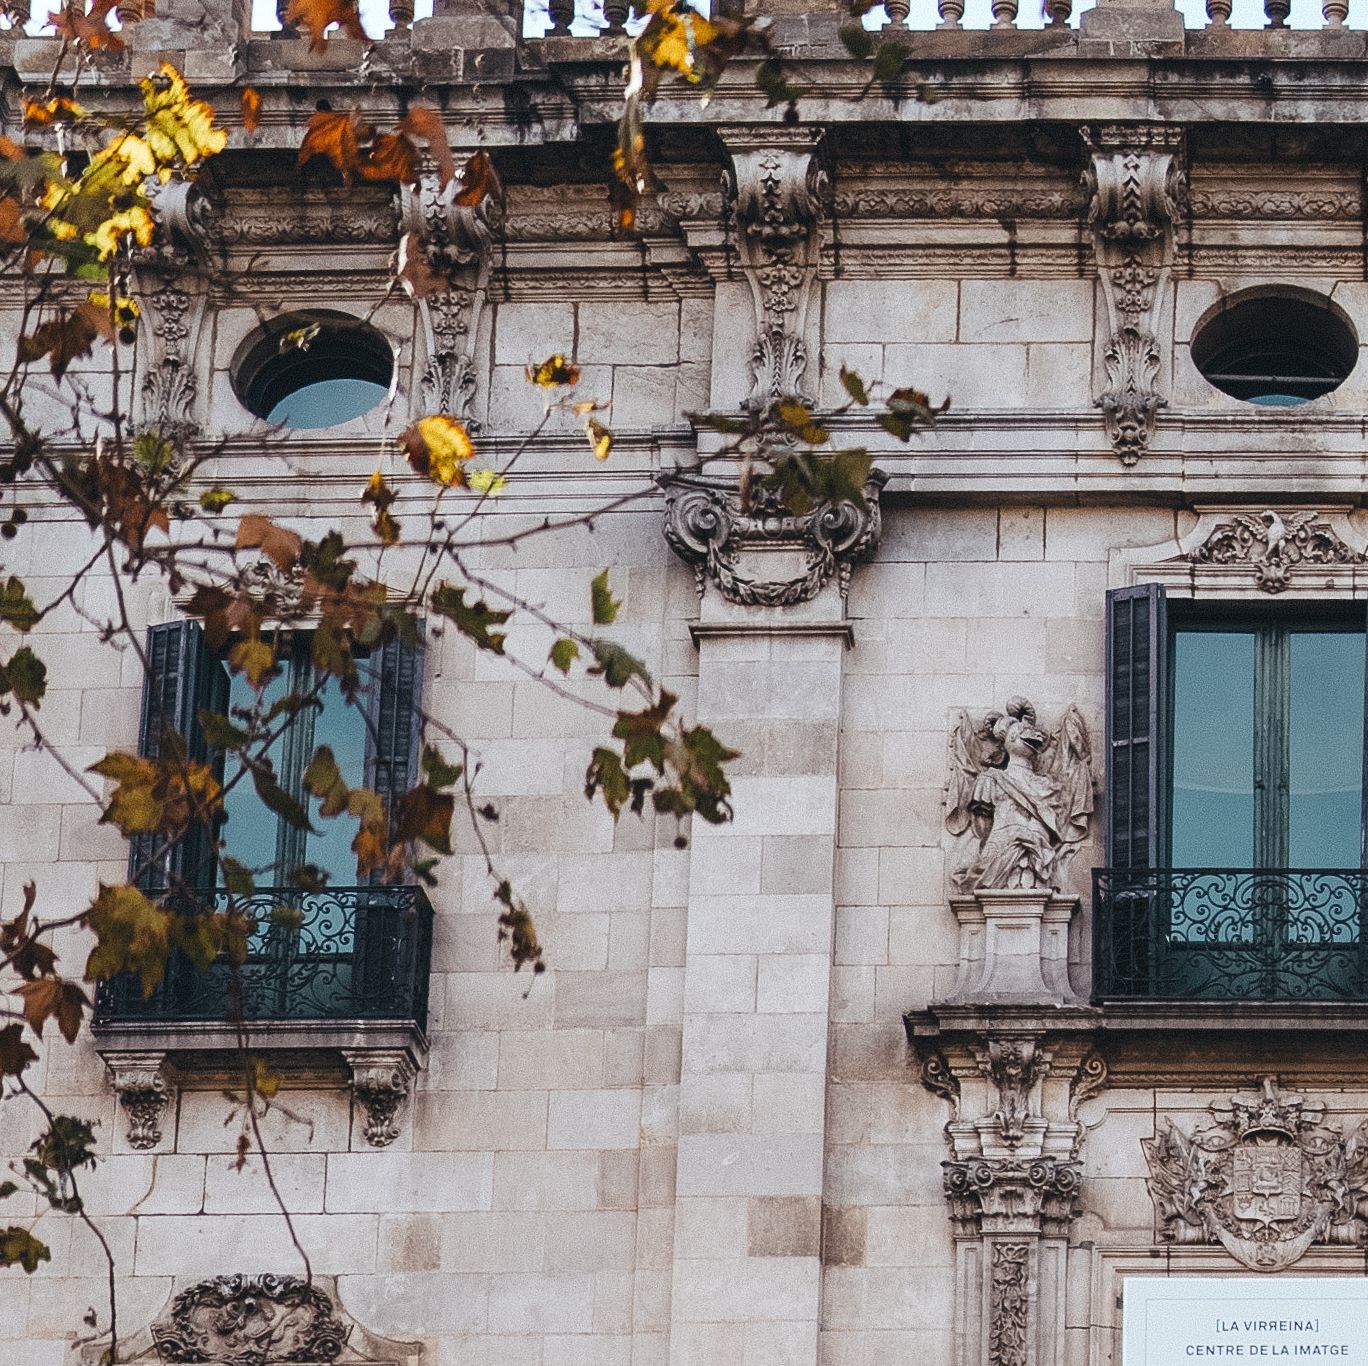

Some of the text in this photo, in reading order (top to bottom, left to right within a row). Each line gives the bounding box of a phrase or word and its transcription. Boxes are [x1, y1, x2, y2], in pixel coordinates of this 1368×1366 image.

[1216, 1318, 1240, 1333] [LA
[1185, 1344, 1349, 1356] CENTRE DE LA IMATGE
